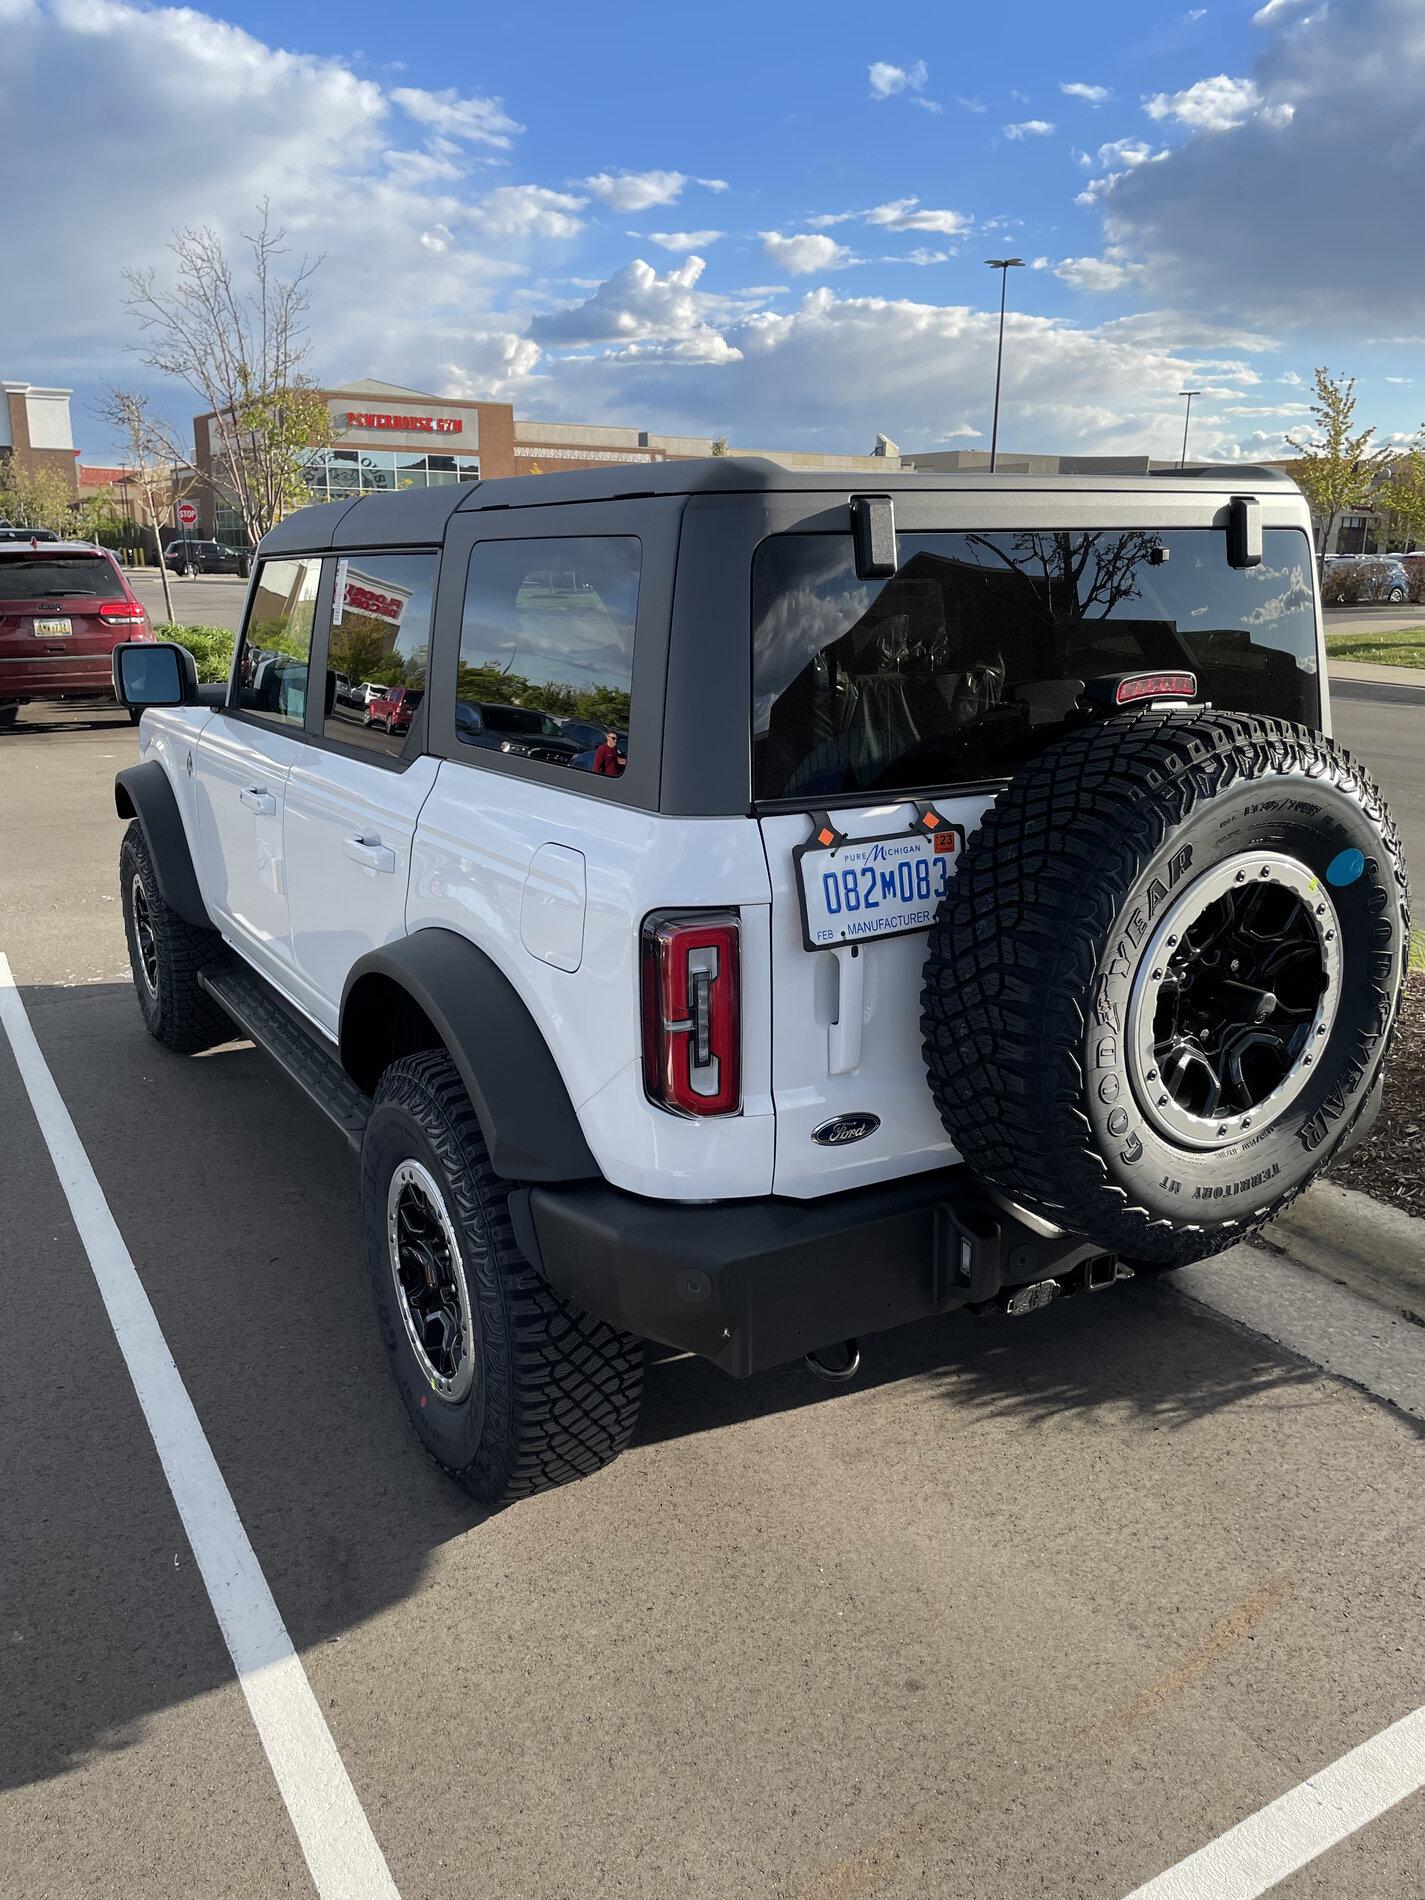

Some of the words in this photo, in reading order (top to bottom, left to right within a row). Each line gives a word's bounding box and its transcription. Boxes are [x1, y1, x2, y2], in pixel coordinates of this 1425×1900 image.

[346, 412, 433, 432] POWERHOUSE
[436, 417, 463, 433] GYM
[179, 509, 197, 519] STOP
[844, 852, 867, 862] PURE
[864, 844, 921, 866] MICHIGAN
[823, 856, 948, 914] 082M083
[847, 910, 930, 936] MANUFACTURER
[817, 930, 834, 941] FEB
[1097, 842, 1195, 1166] GOODYEAR
[829, 1121, 866, 1142] Ford
[1158, 1175, 1183, 1195] MT
[1191, 1162, 1282, 1200] TERRITORY
